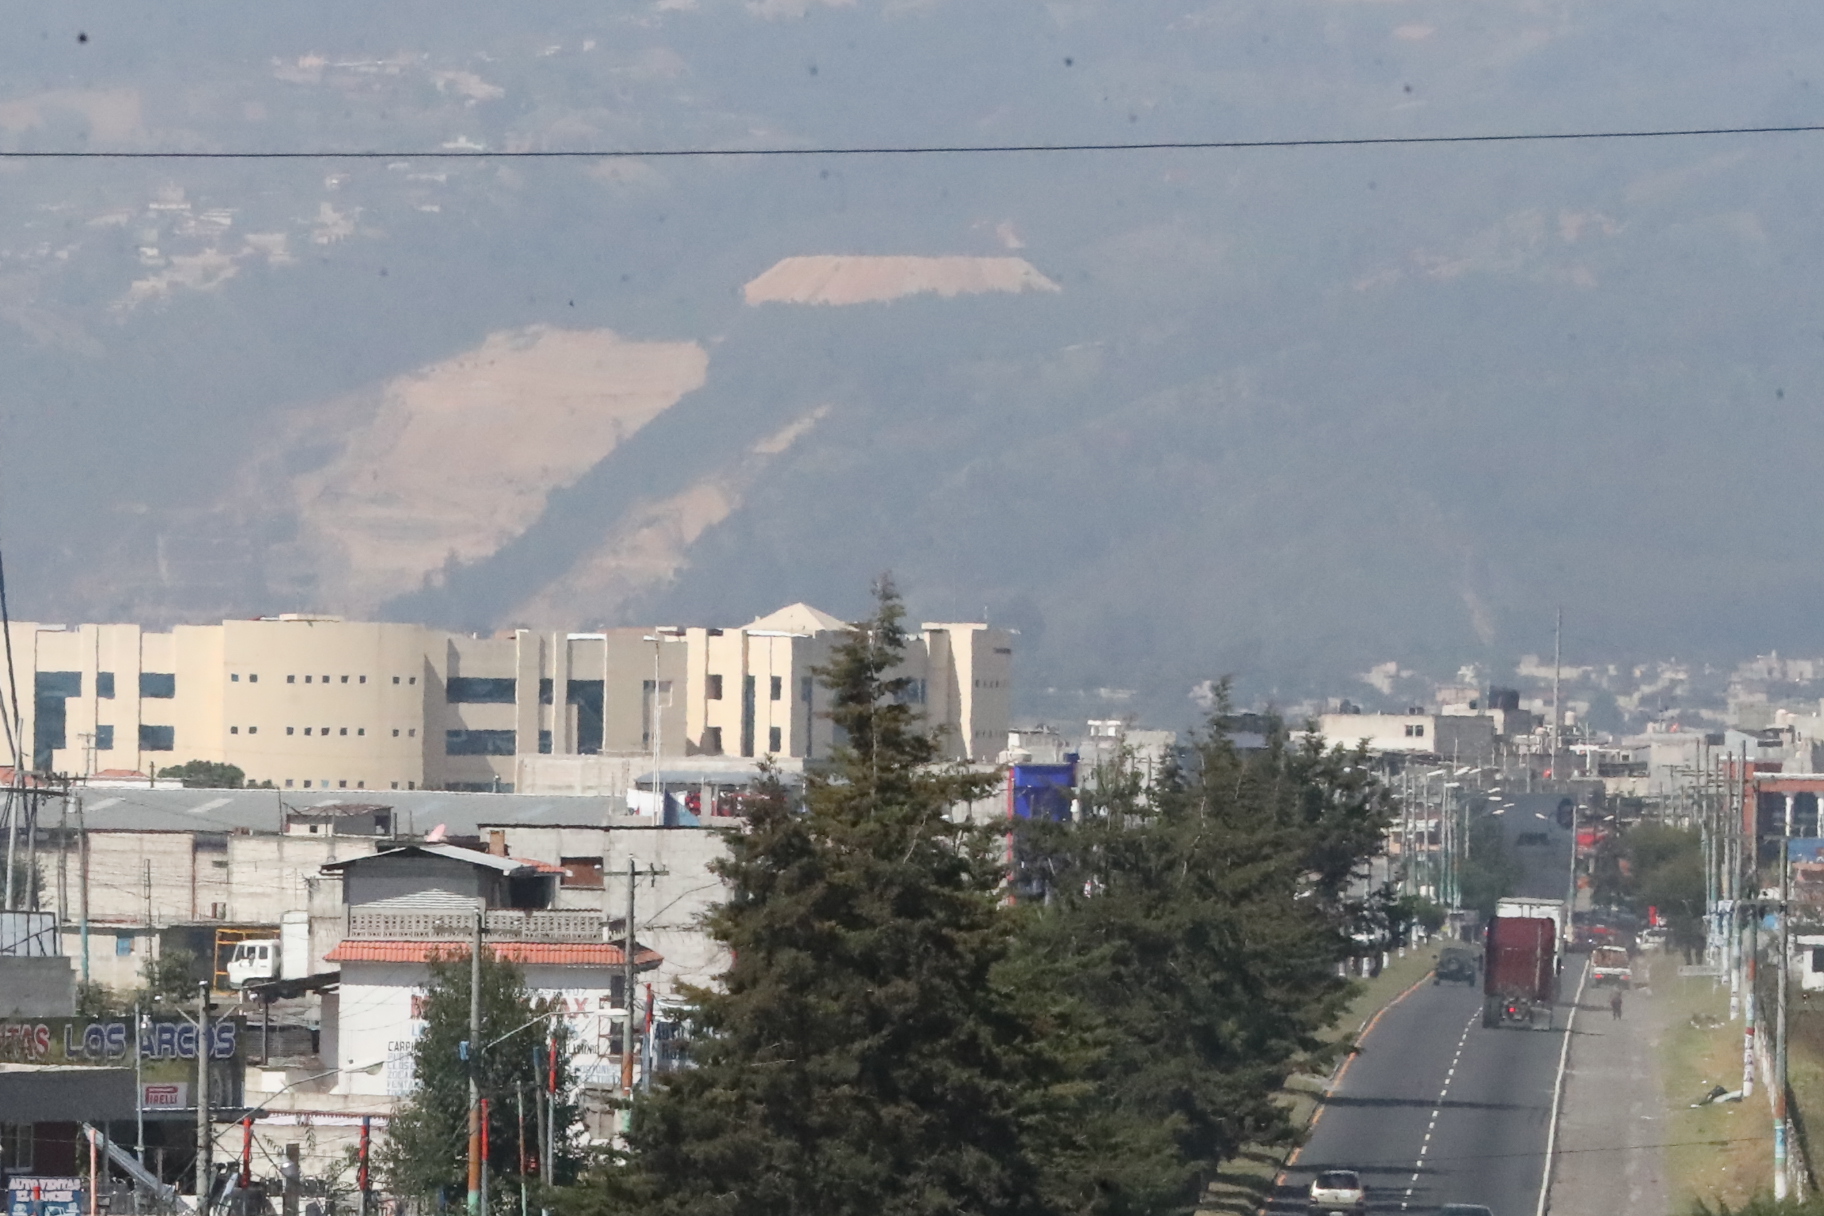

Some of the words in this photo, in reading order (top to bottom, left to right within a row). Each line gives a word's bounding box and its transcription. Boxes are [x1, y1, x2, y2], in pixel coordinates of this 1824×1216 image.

[64, 1022, 126, 1060] LOS
[388, 1040, 414, 1052] CARPI
[145, 1086, 179, 1105] PIRELLI
